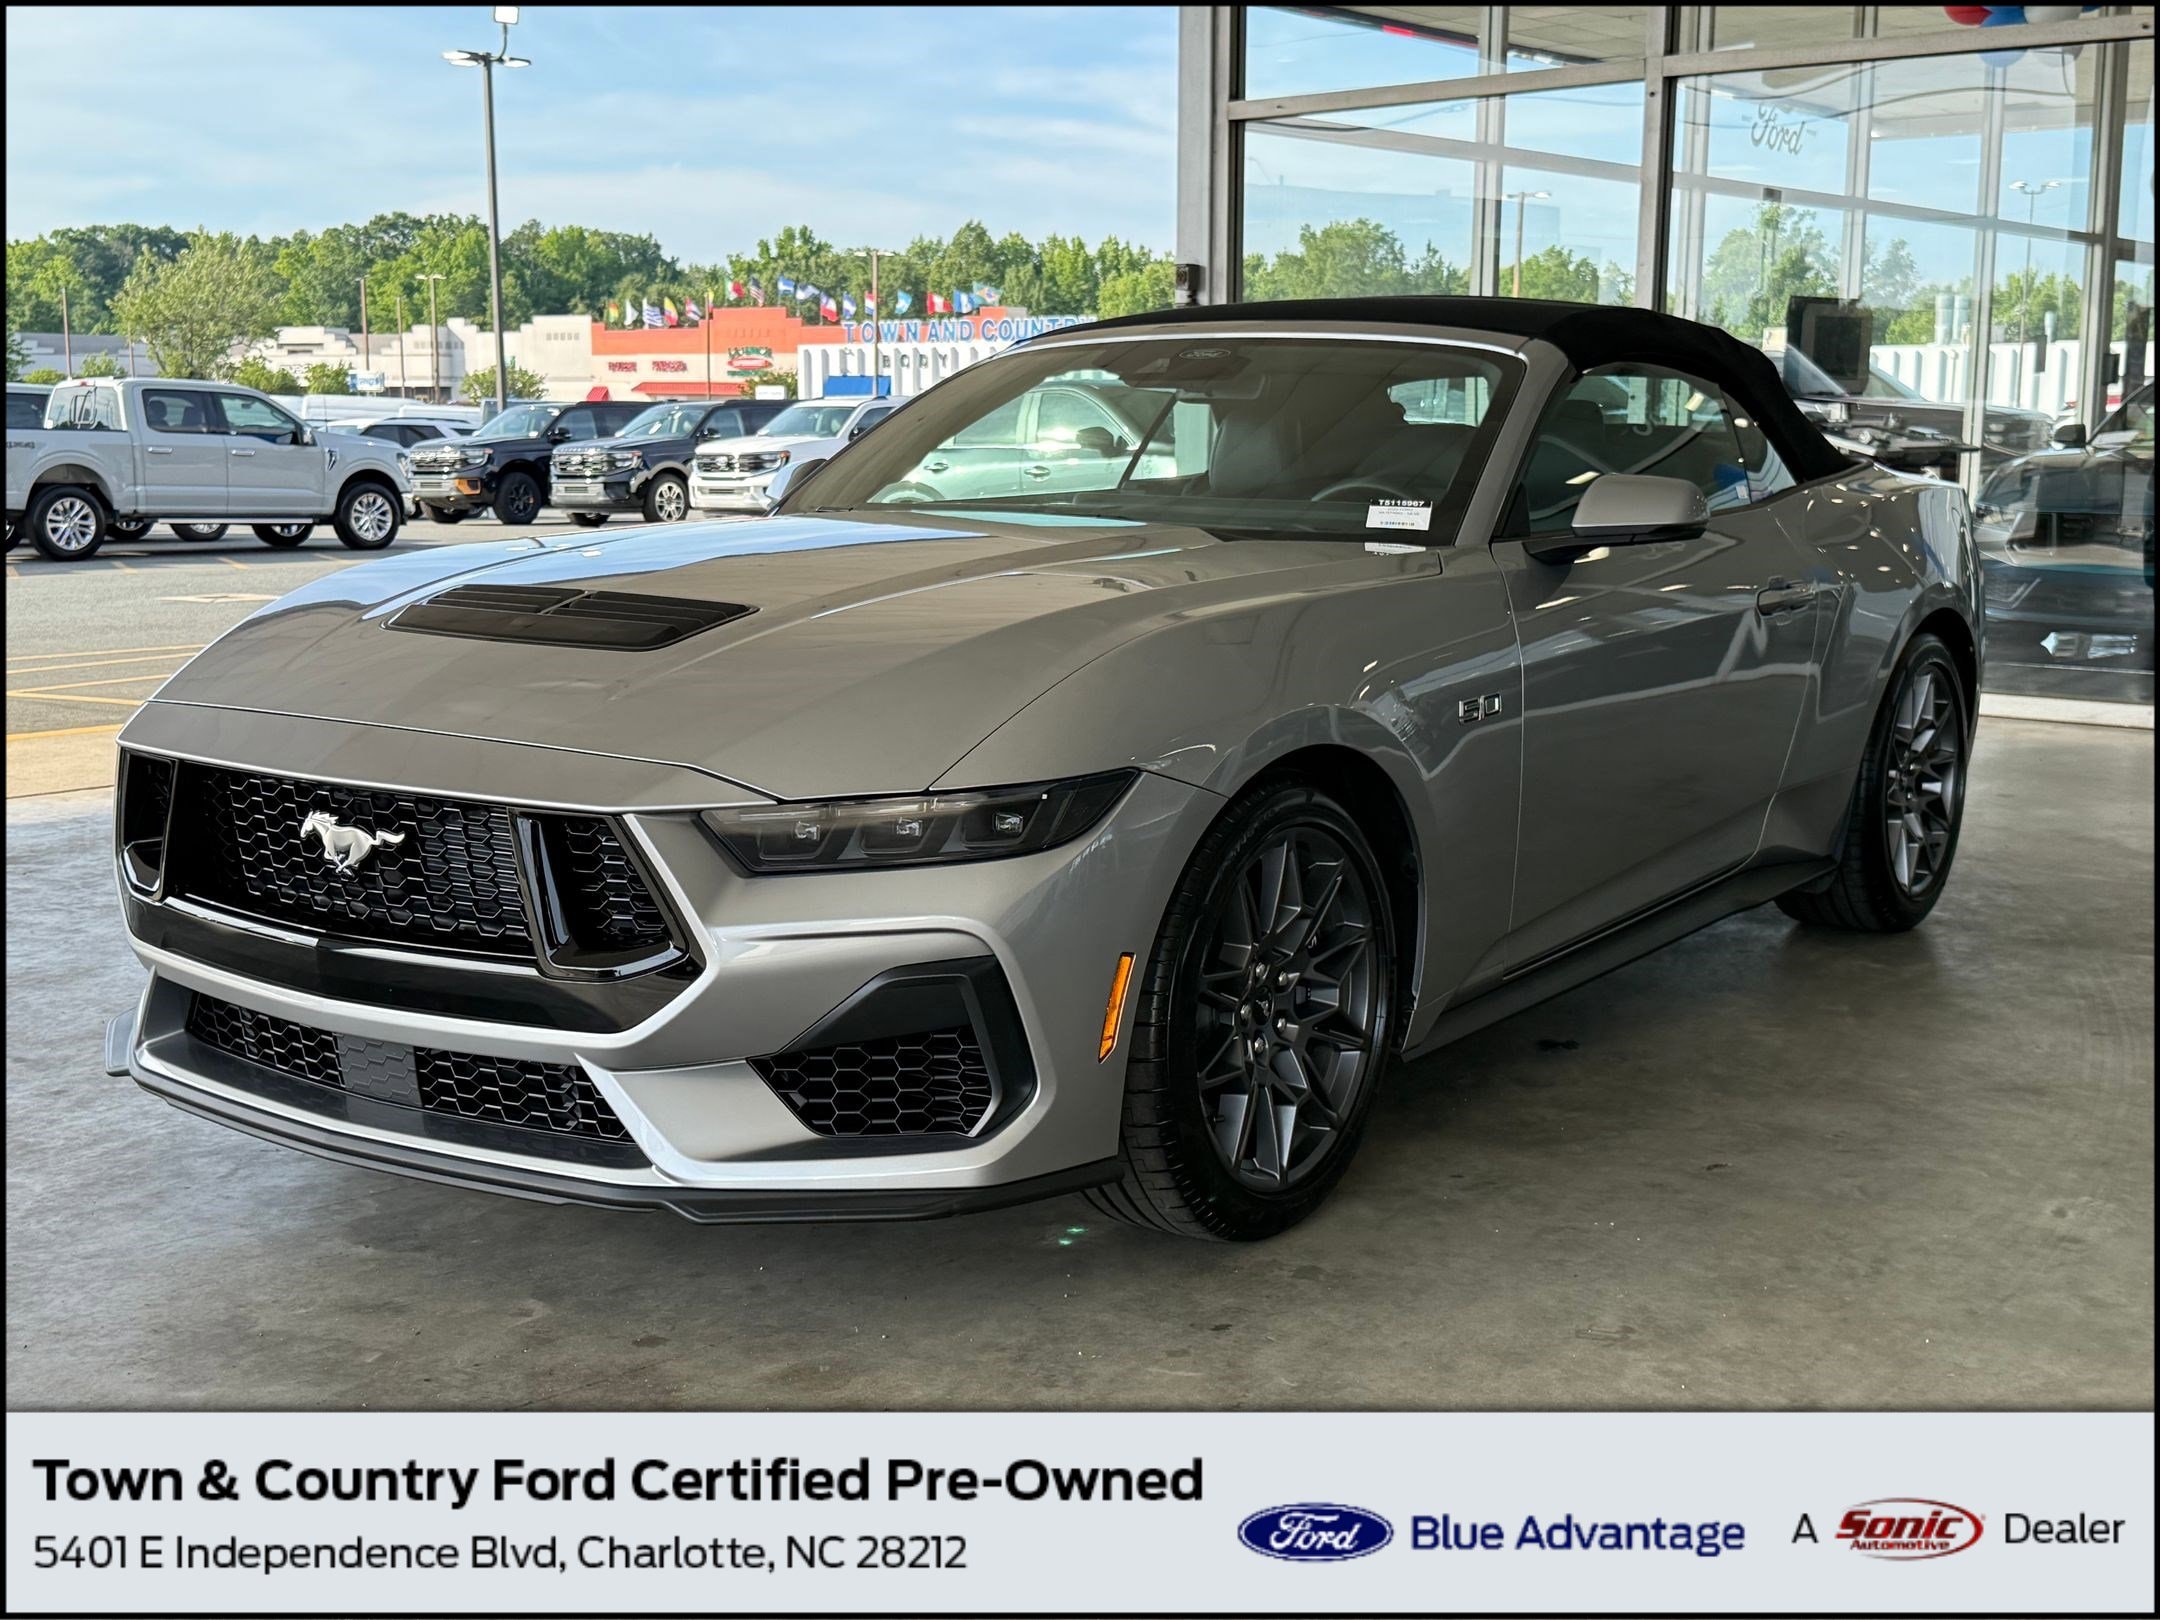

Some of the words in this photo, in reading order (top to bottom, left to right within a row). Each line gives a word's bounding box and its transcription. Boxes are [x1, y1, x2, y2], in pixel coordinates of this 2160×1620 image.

[1751, 103, 1806, 155] Ford
[842, 319, 921, 344] TOWN
[927, 318, 976, 343] AND
[980, 314, 1097, 342] COUNT
[882, 353, 948, 369] BODY
